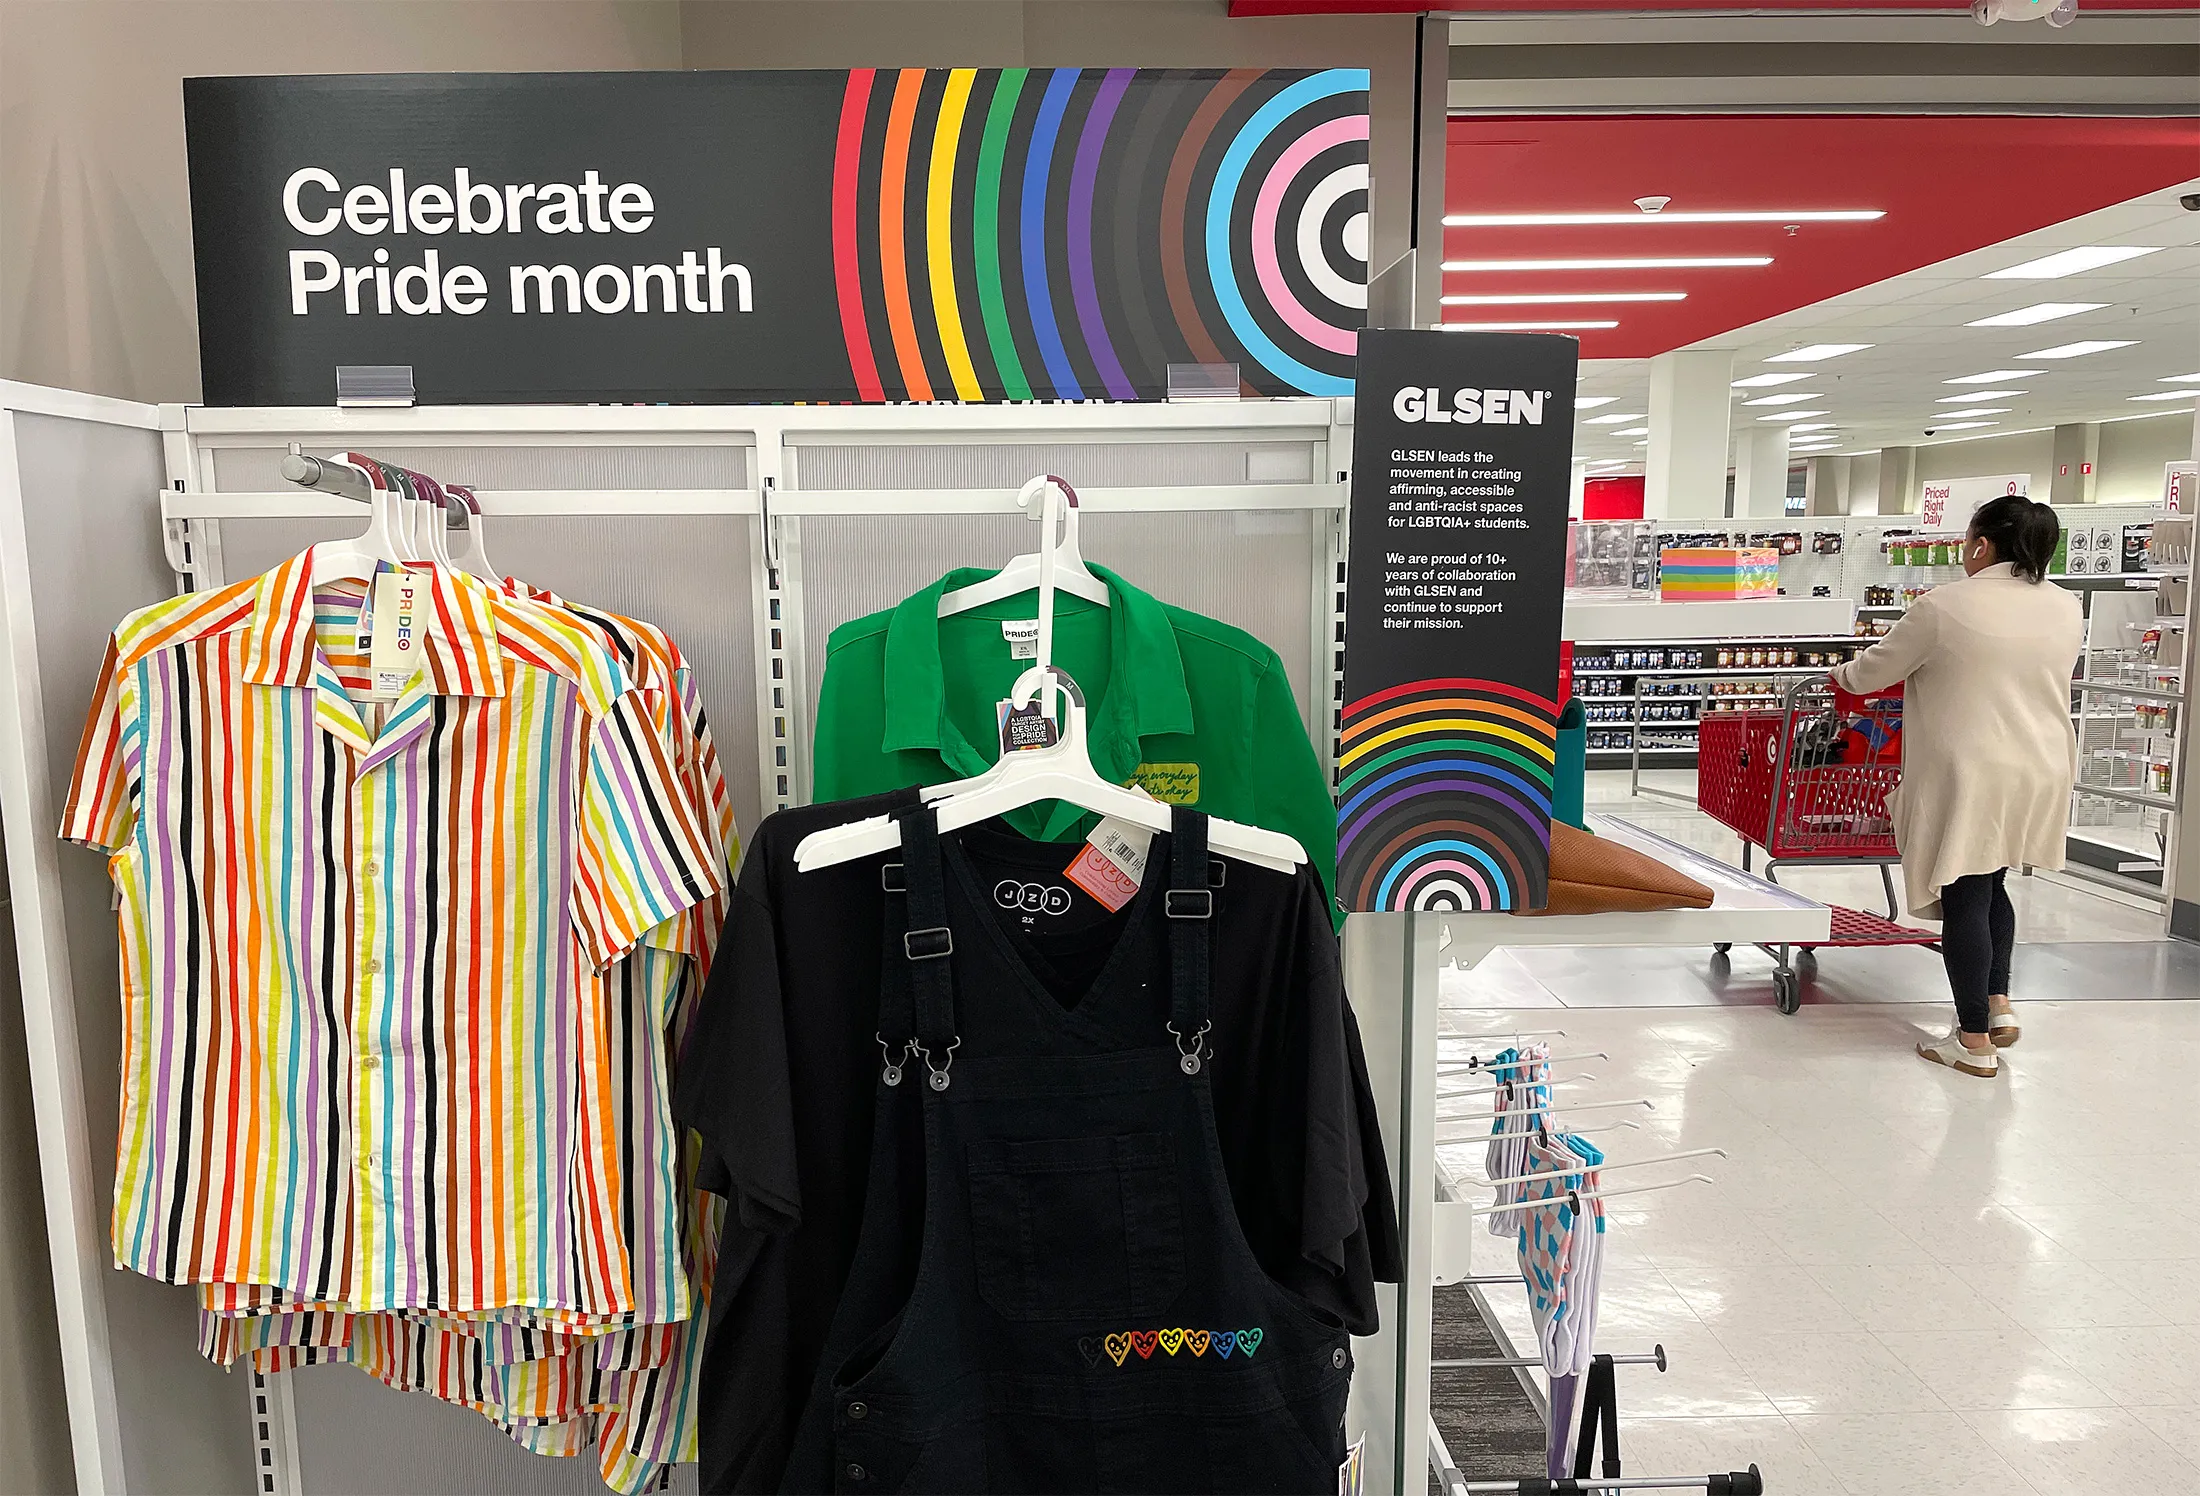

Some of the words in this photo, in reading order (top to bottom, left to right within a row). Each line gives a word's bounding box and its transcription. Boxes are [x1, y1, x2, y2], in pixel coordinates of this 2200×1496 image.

[283, 167, 655, 236] Celebrate
[289, 248, 488, 315] Pride
[510, 247, 753, 314] month
[1390, 449, 1435, 462] GLSEN
[1437, 450, 1471, 463] leads
[1473, 451, 1494, 463] the
[396, 473, 404, 481] M
[1390, 467, 1455, 479] movement
[1457, 467, 1469, 480] in
[1471, 467, 1522, 483] creating
[1389, 482, 1447, 498] affirming,
[1449, 484, 1515, 497] accessible
[1925, 486, 1950, 499] Priced
[1388, 499, 1413, 511] and
[1414, 499, 1478, 512] anti-racist
[1479, 503, 1524, 516] spaces
[1924, 501, 1944, 514] Right
[1387, 515, 1406, 528] for
[1408, 515, 1472, 529] LGBTQIA+
[1473, 516, 1530, 529] students.
[1923, 513, 1943, 527] Daily
[1386, 552, 1406, 564] We
[1407, 554, 1429, 565] are
[1430, 552, 1467, 567] proud
[1469, 553, 1483, 565] of
[1485, 553, 1507, 565] 10+
[1384, 571, 1419, 584] years
[1421, 568, 1435, 581] of
[1437, 569, 1516, 581] collaboration
[1384, 584, 1411, 597] with
[1413, 584, 1457, 597] GLSEN
[1459, 585, 1483, 597] and
[398, 588, 414, 639] PRIDE
[1383, 601, 1437, 613] continue
[1439, 601, 1453, 613] to
[1454, 601, 1503, 615] support
[1382, 617, 1412, 629] their
[1413, 617, 1464, 629] mission.
[1005, 630, 1033, 638] PRIDE
[1011, 724, 1046, 734] DESIGN
[1020, 731, 1047, 739] PRIDE
[1021, 916, 1035, 924] 2X
